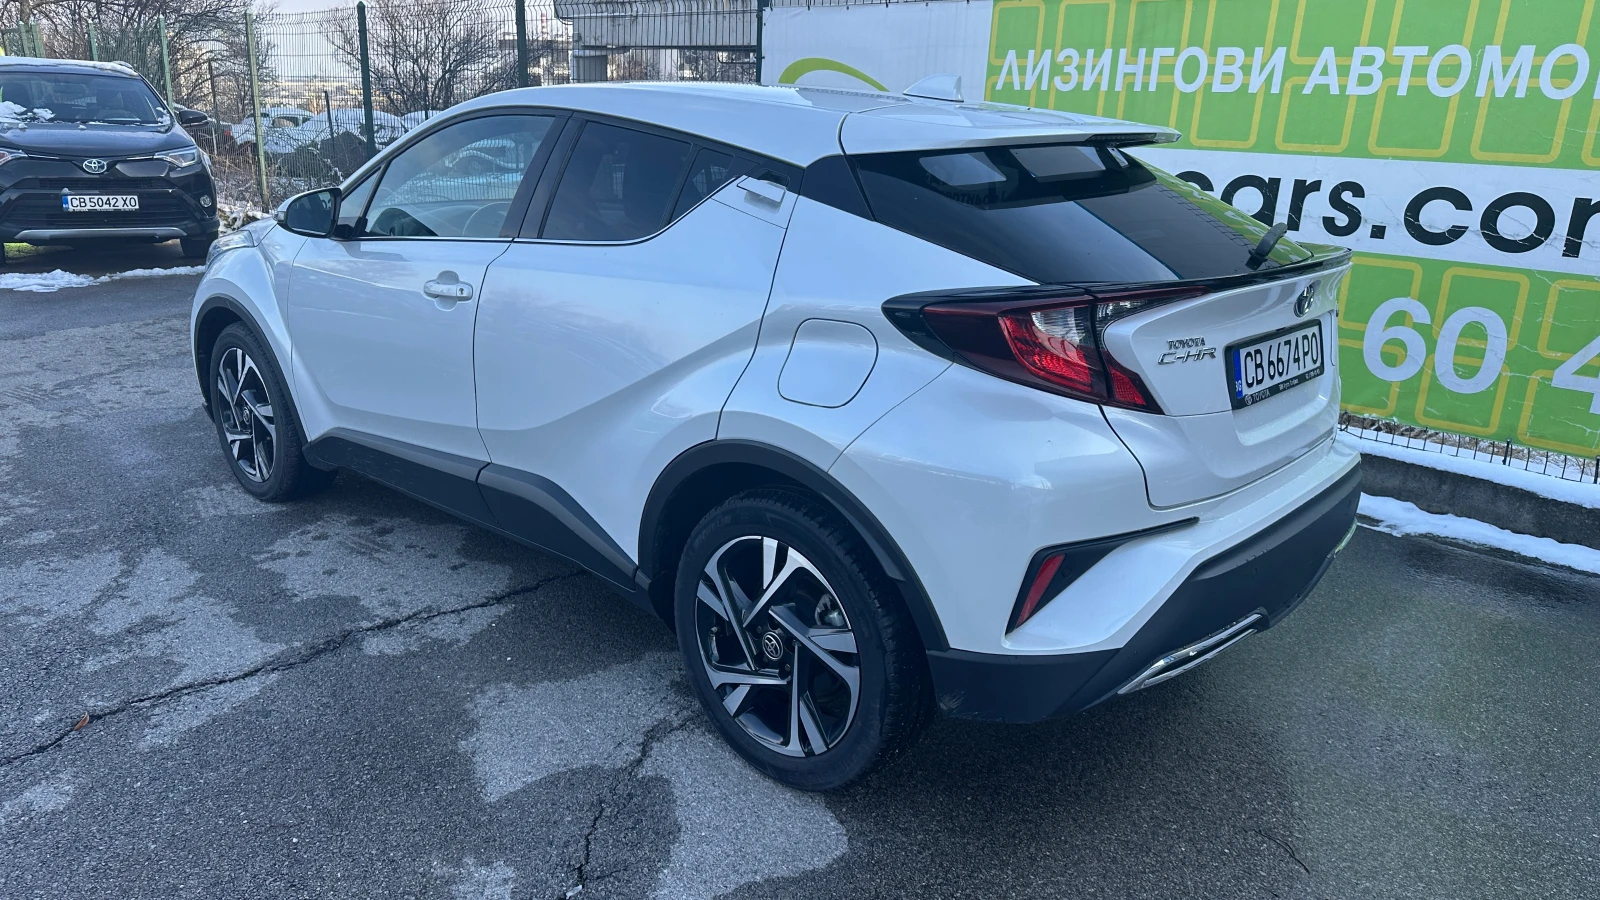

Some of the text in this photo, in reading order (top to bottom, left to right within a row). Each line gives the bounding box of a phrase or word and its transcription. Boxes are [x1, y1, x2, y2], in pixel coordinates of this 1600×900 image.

[996, 43, 1600, 100] ЛИЗИНГОВИ АВТОМО
[70, 197, 87, 208] CB
[88, 197, 119, 208] 5042
[1167, 336, 1206, 350] TOYOTA
[1363, 297, 1508, 394] 60
[1158, 347, 1216, 365] C-HR
